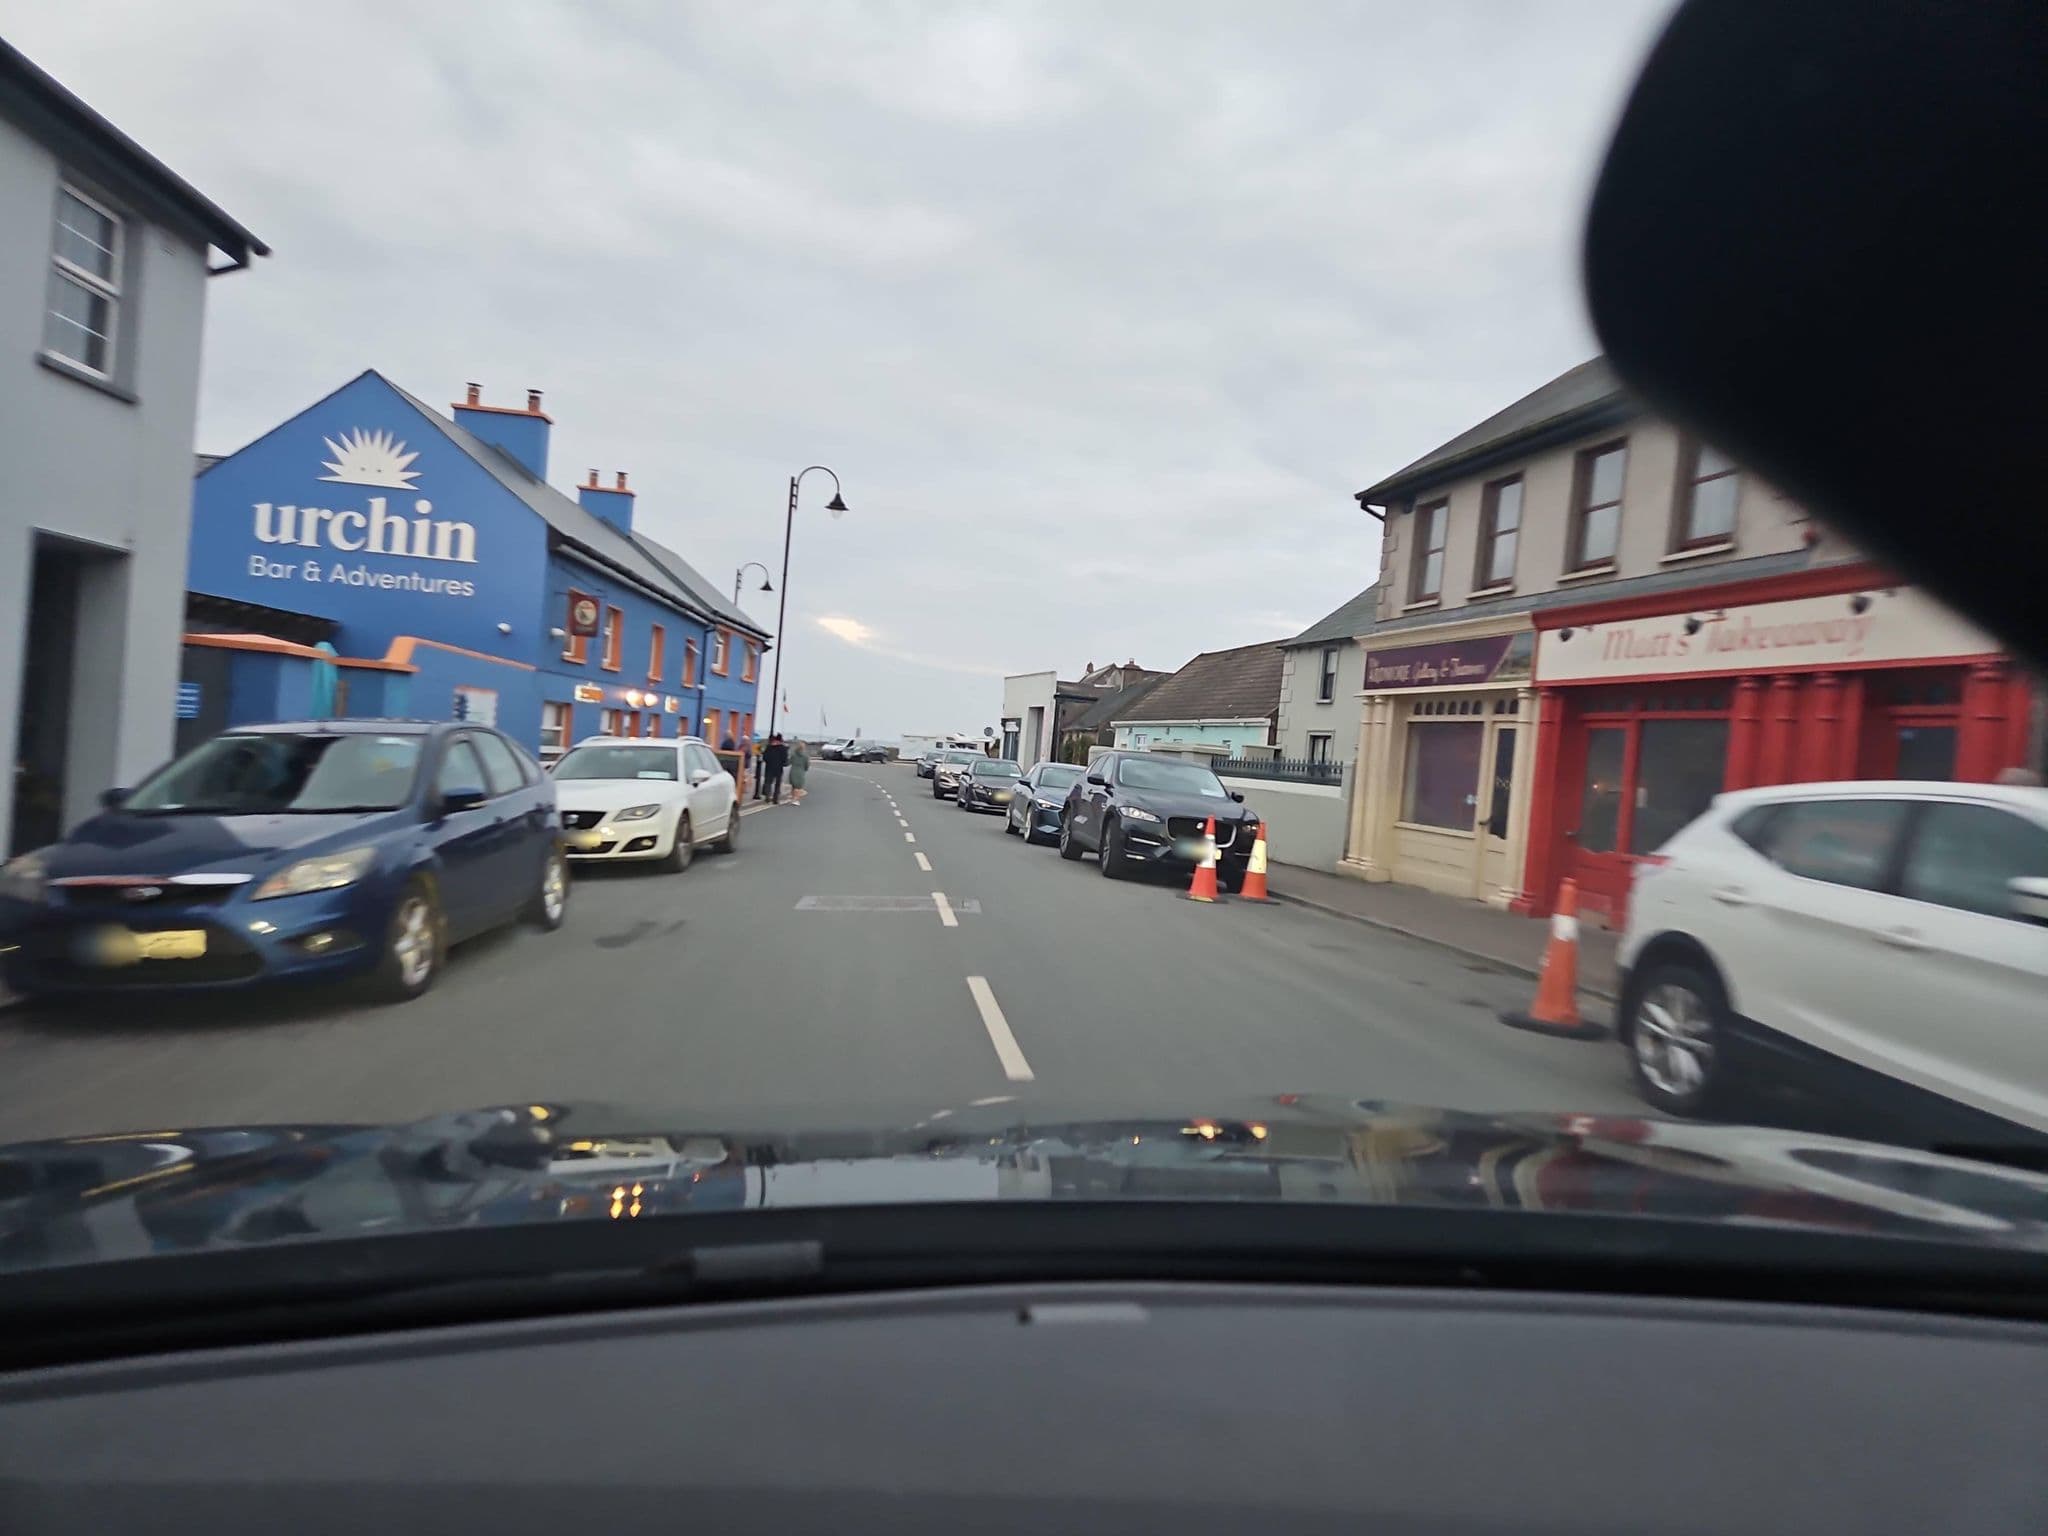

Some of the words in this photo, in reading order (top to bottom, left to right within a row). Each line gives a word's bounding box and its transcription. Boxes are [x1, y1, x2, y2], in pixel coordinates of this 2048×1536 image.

[252, 497, 479, 563] urchin
[249, 555, 297, 579] Bar
[302, 560, 322, 582] &
[328, 564, 475, 597] Adventures
